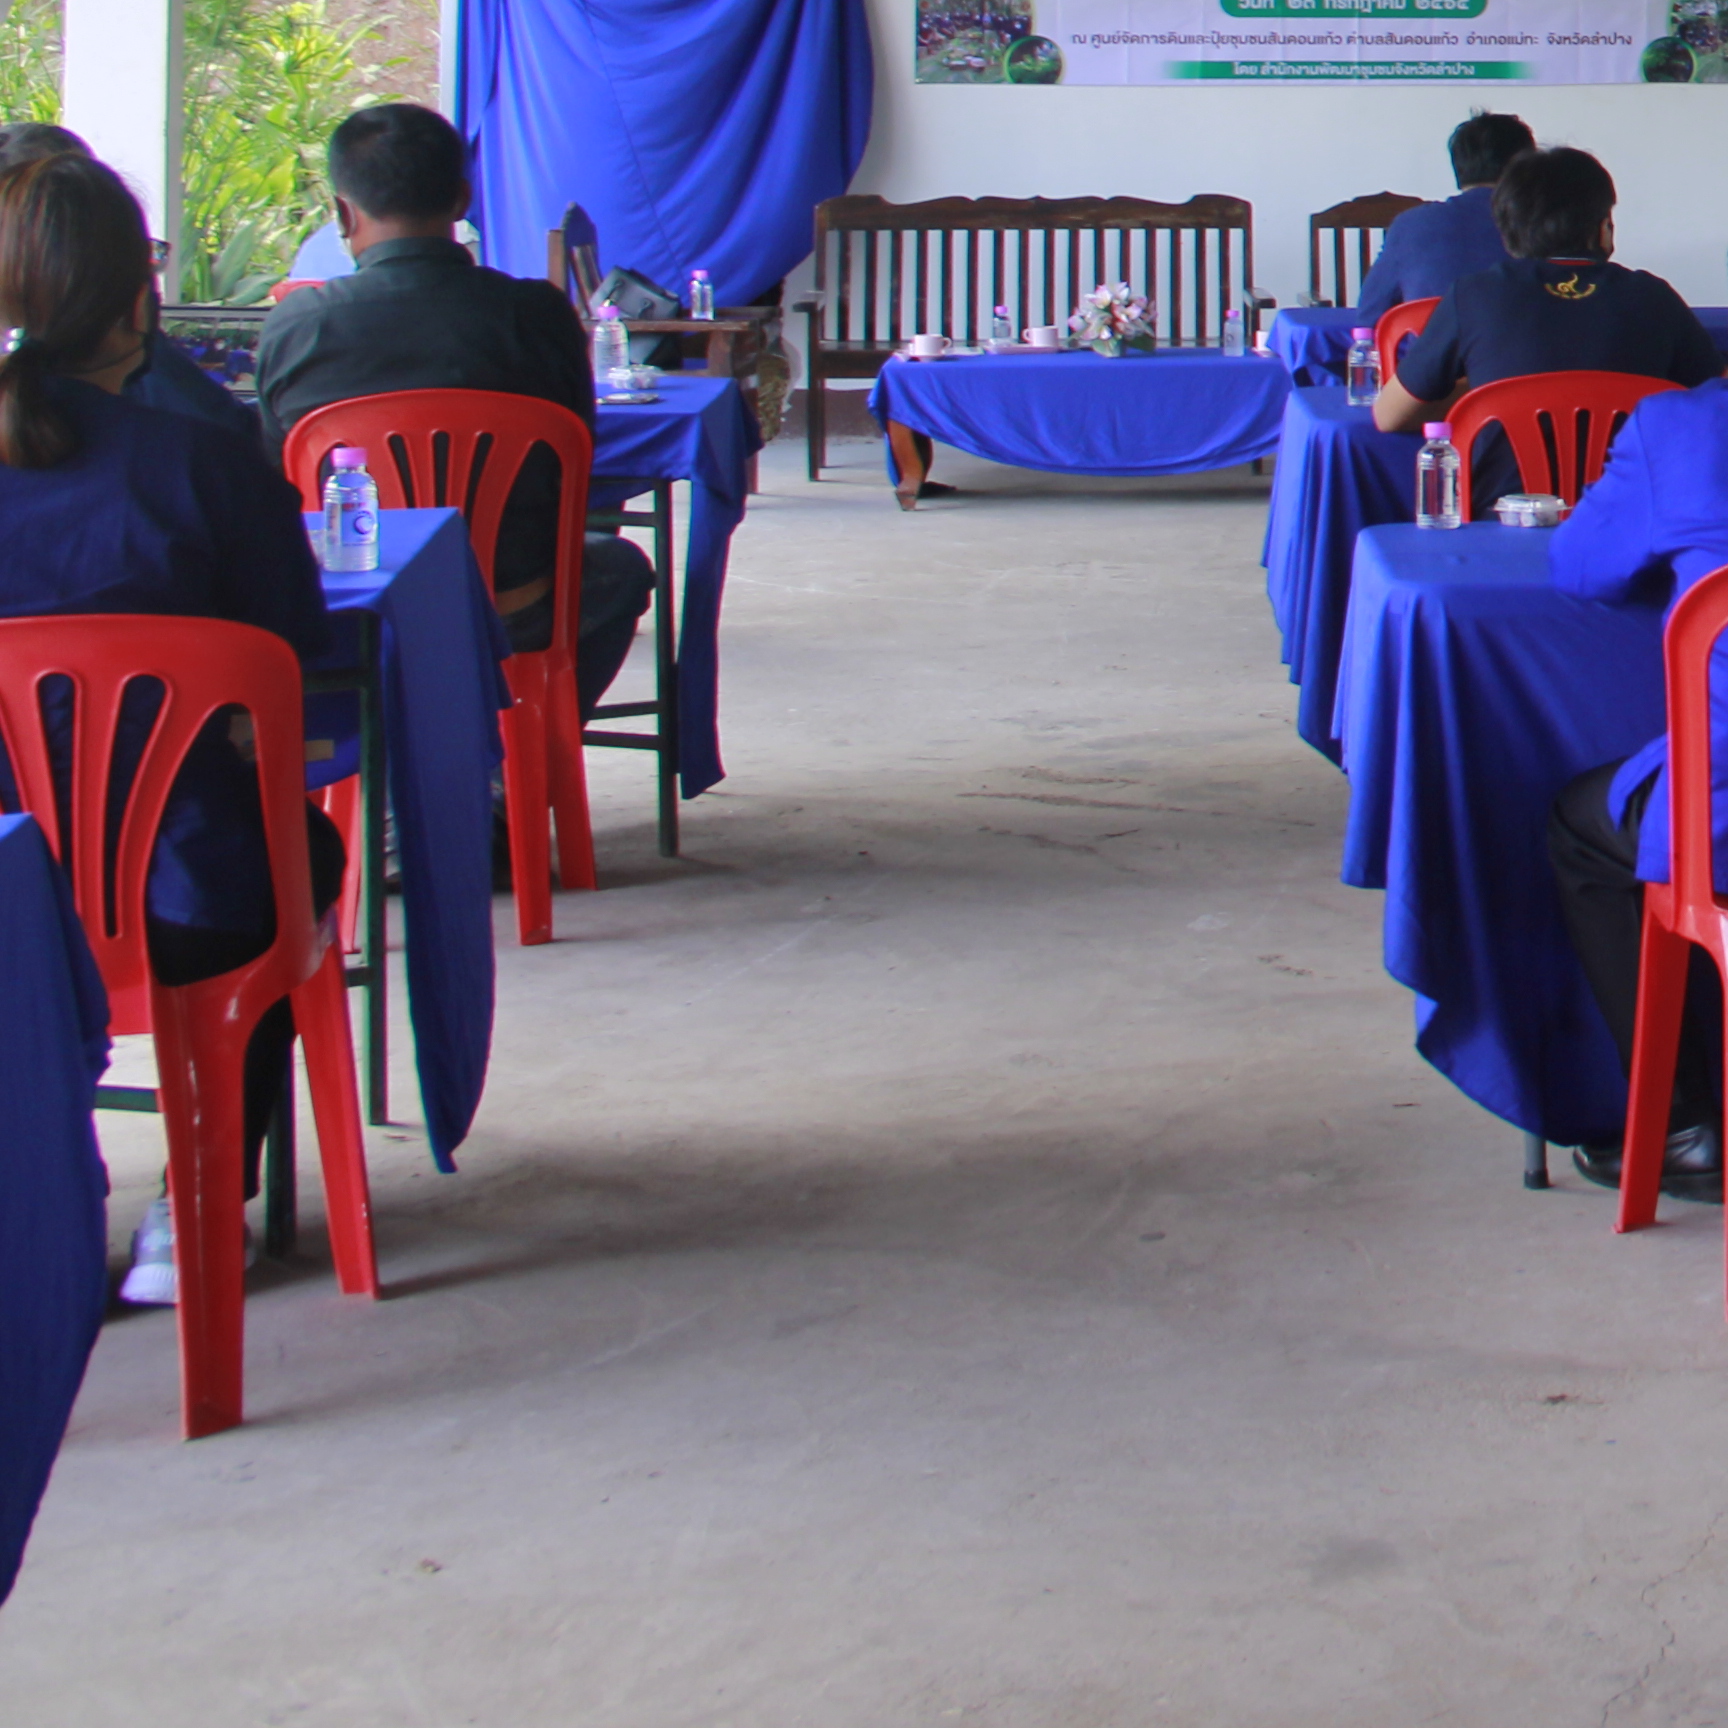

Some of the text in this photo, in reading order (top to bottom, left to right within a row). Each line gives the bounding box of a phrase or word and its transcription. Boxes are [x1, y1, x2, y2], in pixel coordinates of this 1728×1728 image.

[1072, 32, 1087, 45] ณ
[1346, 31, 1458, 46] ตำบลสันดอนแก้ว
[1466, 30, 1539, 46] อำเภอแม่ทะ
[1547, 31, 1632, 46] จังหวัดลำปาง
[1233, 61, 1257, 76] โดย
